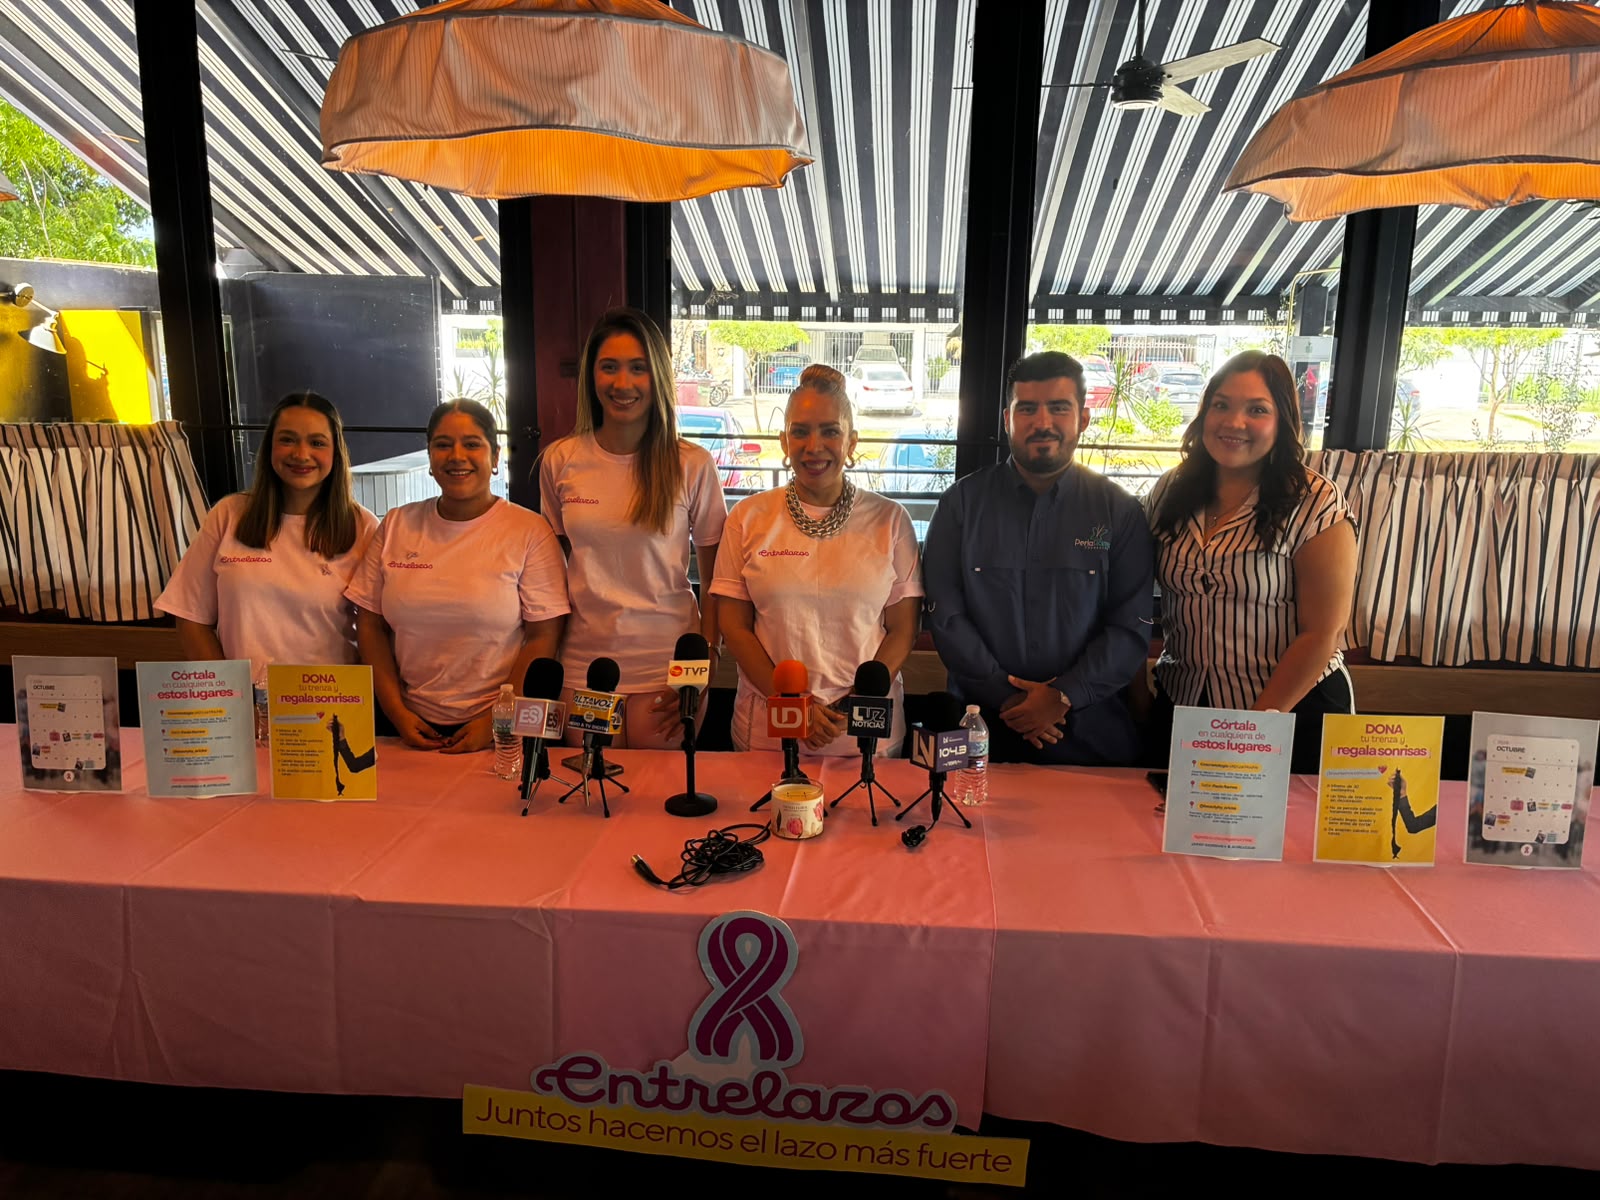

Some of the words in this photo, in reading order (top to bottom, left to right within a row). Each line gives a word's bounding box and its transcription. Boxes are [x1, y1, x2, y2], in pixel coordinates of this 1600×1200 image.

[171, 669, 216, 681] Córtala
[683, 666, 708, 676] TVP
[172, 680, 214, 690] cualquiera
[215, 679, 226, 688] de
[302, 674, 336, 684] DONA
[298, 684, 306, 692] tu
[308, 684, 332, 692] trenza
[157, 689, 188, 700] estos
[189, 688, 234, 701] lugares
[281, 693, 316, 705] regala
[316, 692, 360, 703] sonrisas
[852, 720, 885, 729] NOTICIAS
[1210, 718, 1257, 731] Córtala
[1365, 723, 1403, 735] DONA
[1210, 730, 1253, 740] cualquiera
[1255, 732, 1266, 740] de
[1360, 735, 1369, 743] tu
[1371, 735, 1398, 743] trenza
[1400, 736, 1406, 745] y
[1192, 739, 1226, 750] estos
[1227, 740, 1272, 754] lugares
[1337, 745, 1377, 758] regala
[1377, 744, 1427, 756] sonrisas
[1496, 745, 1526, 753] OCTUBRE
[475, 1097, 582, 1133] Juntos
[589, 1110, 734, 1150] hacemos
[740, 1128, 767, 1154] el
[774, 1130, 838, 1160] lazo
[844, 1140, 910, 1167] más
[917, 1142, 1012, 1173] fuerte
